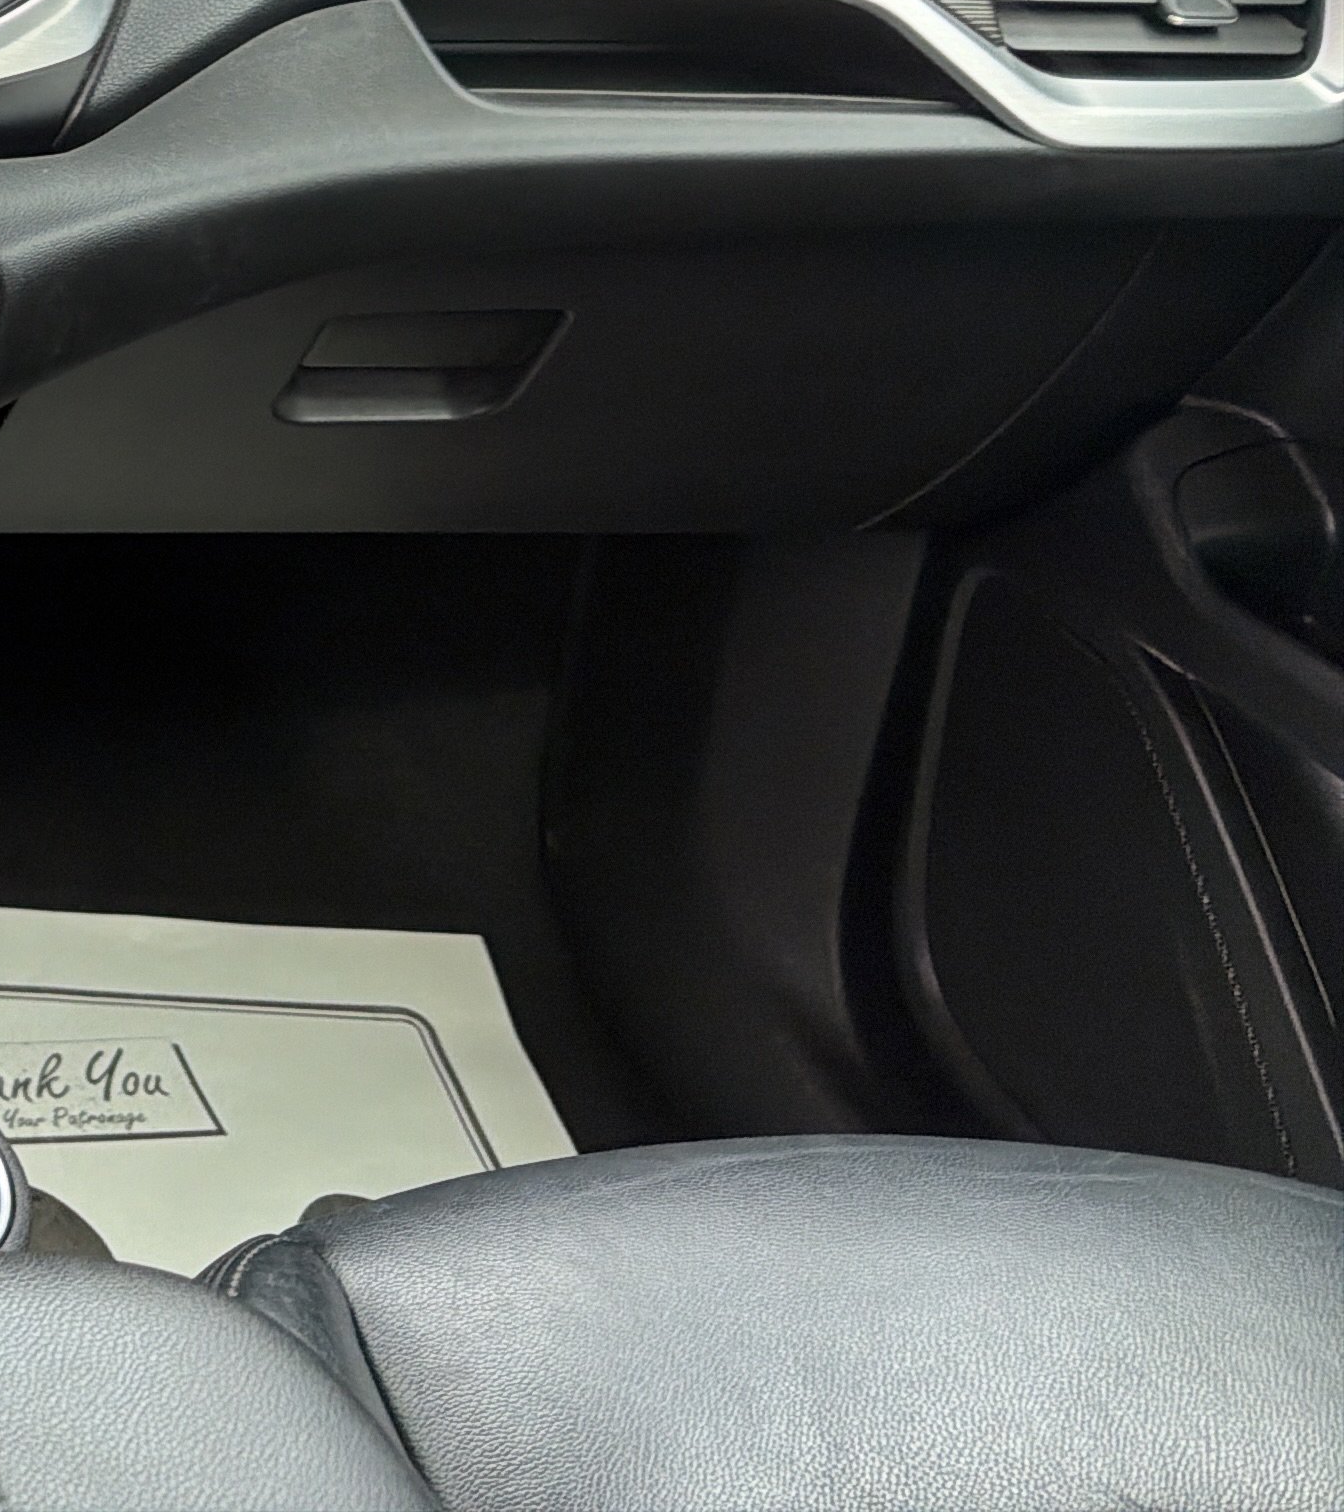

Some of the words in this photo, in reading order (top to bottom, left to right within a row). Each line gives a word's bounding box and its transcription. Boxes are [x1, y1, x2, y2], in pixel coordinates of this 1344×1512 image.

[85, 1047, 170, 1102] You
[2, 1107, 46, 1129] Your
[53, 1106, 146, 1130] Patronage
